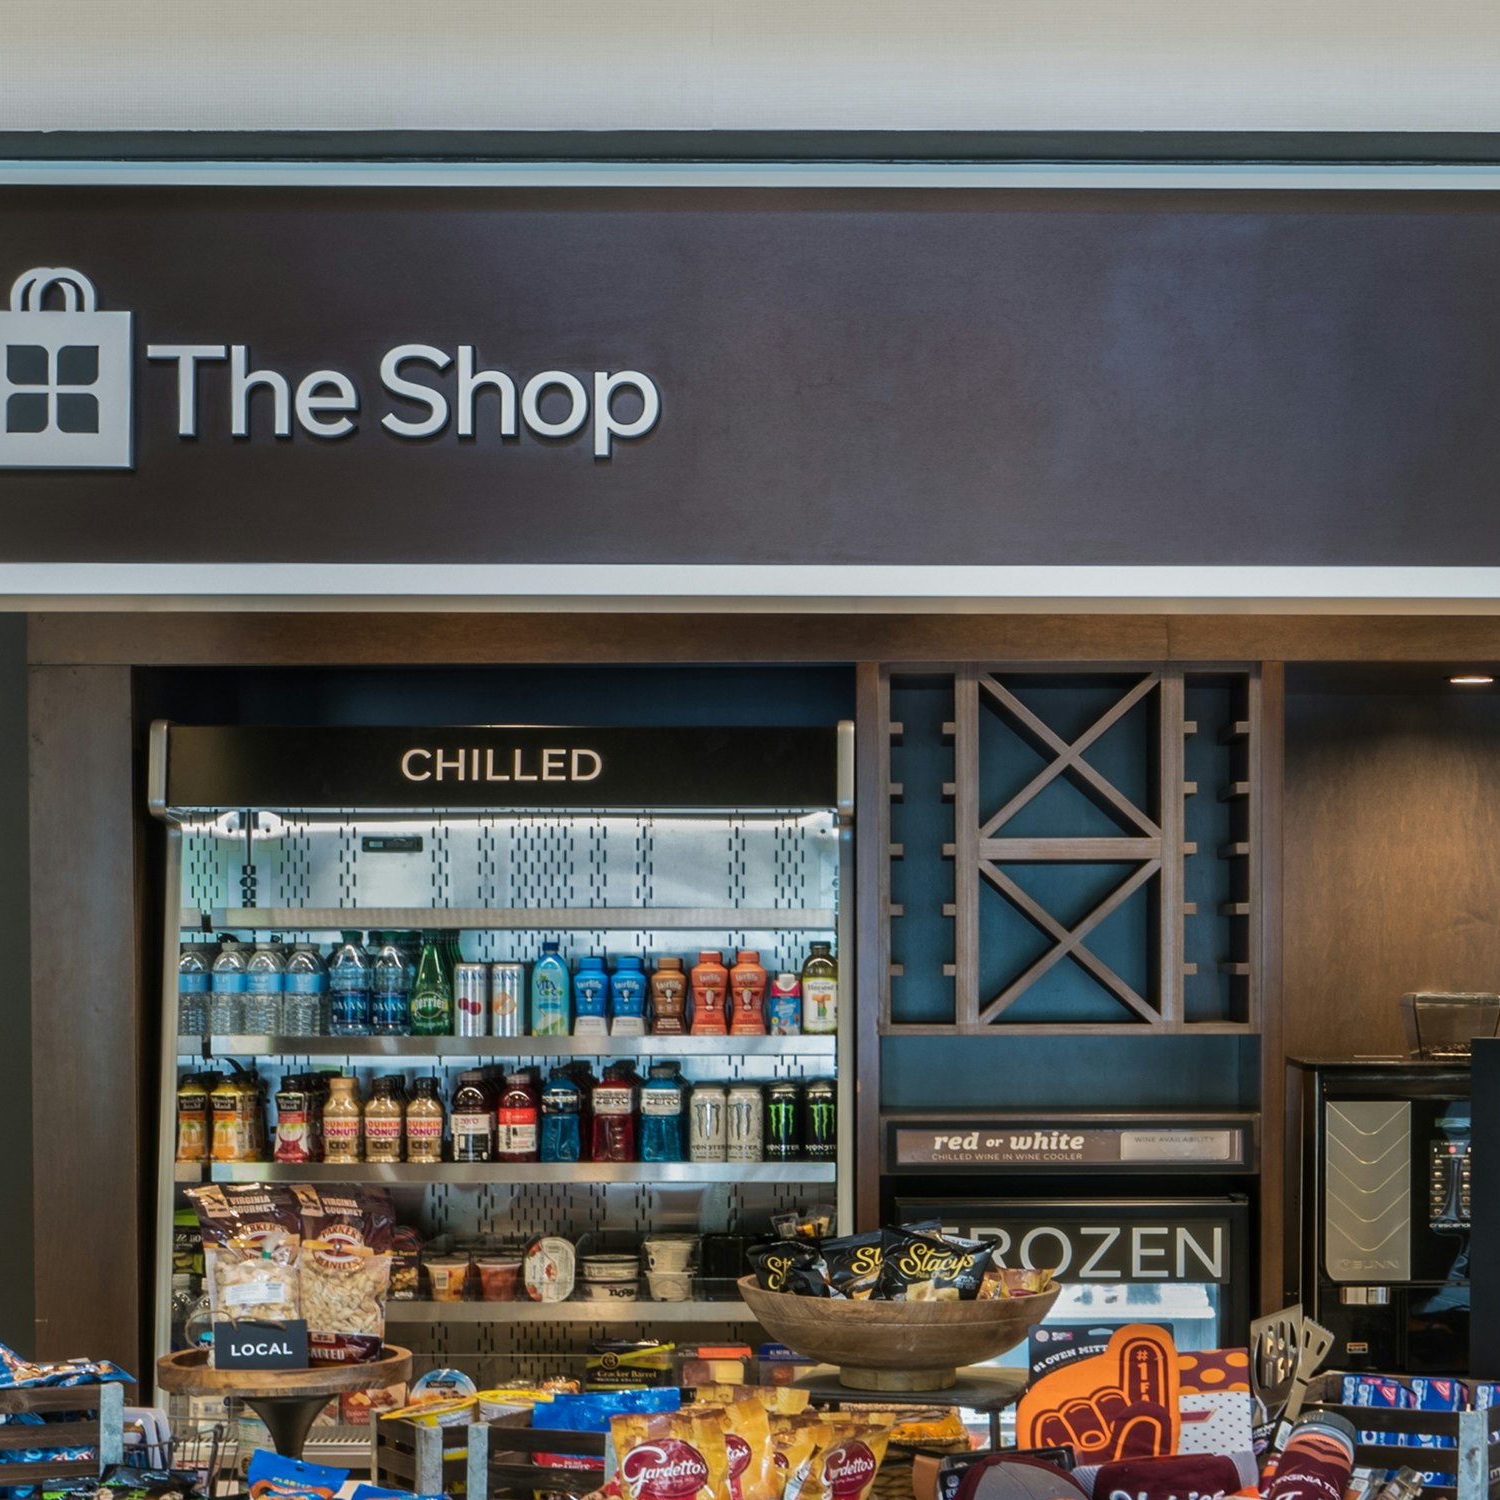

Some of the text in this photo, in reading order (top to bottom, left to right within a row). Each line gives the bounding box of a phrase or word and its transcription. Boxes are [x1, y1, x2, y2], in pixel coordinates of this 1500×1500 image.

[147, 343, 661, 459] The Shop
[401, 748, 603, 783] CHILLED
[324, 1128, 358, 1137] DONUTS
[367, 1128, 401, 1137] DONUTS
[406, 1128, 441, 1137] DONUTS
[934, 1131, 1085, 1150] red or white
[932, 1153, 972, 1161] CHILLED
[975, 1153, 1001, 1161] WINE
[1013, 1153, 1041, 1161] WINE
[1043, 1152, 1083, 1160] COOLER
[231, 1203, 276, 1214] GOURMET
[323, 1197, 358, 1208] VIRGINIA
[942, 1227, 1222, 1278] ROZEN
[900, 1243, 975, 1281] Stacy's
[231, 1342, 293, 1357] LOCAL
[309, 1348, 345, 1361] ALTED
[1045, 1348, 1077, 1365] OVEN
[1078, 1344, 1108, 1355] MITT
[622, 1446, 707, 1498] Gardetto's
